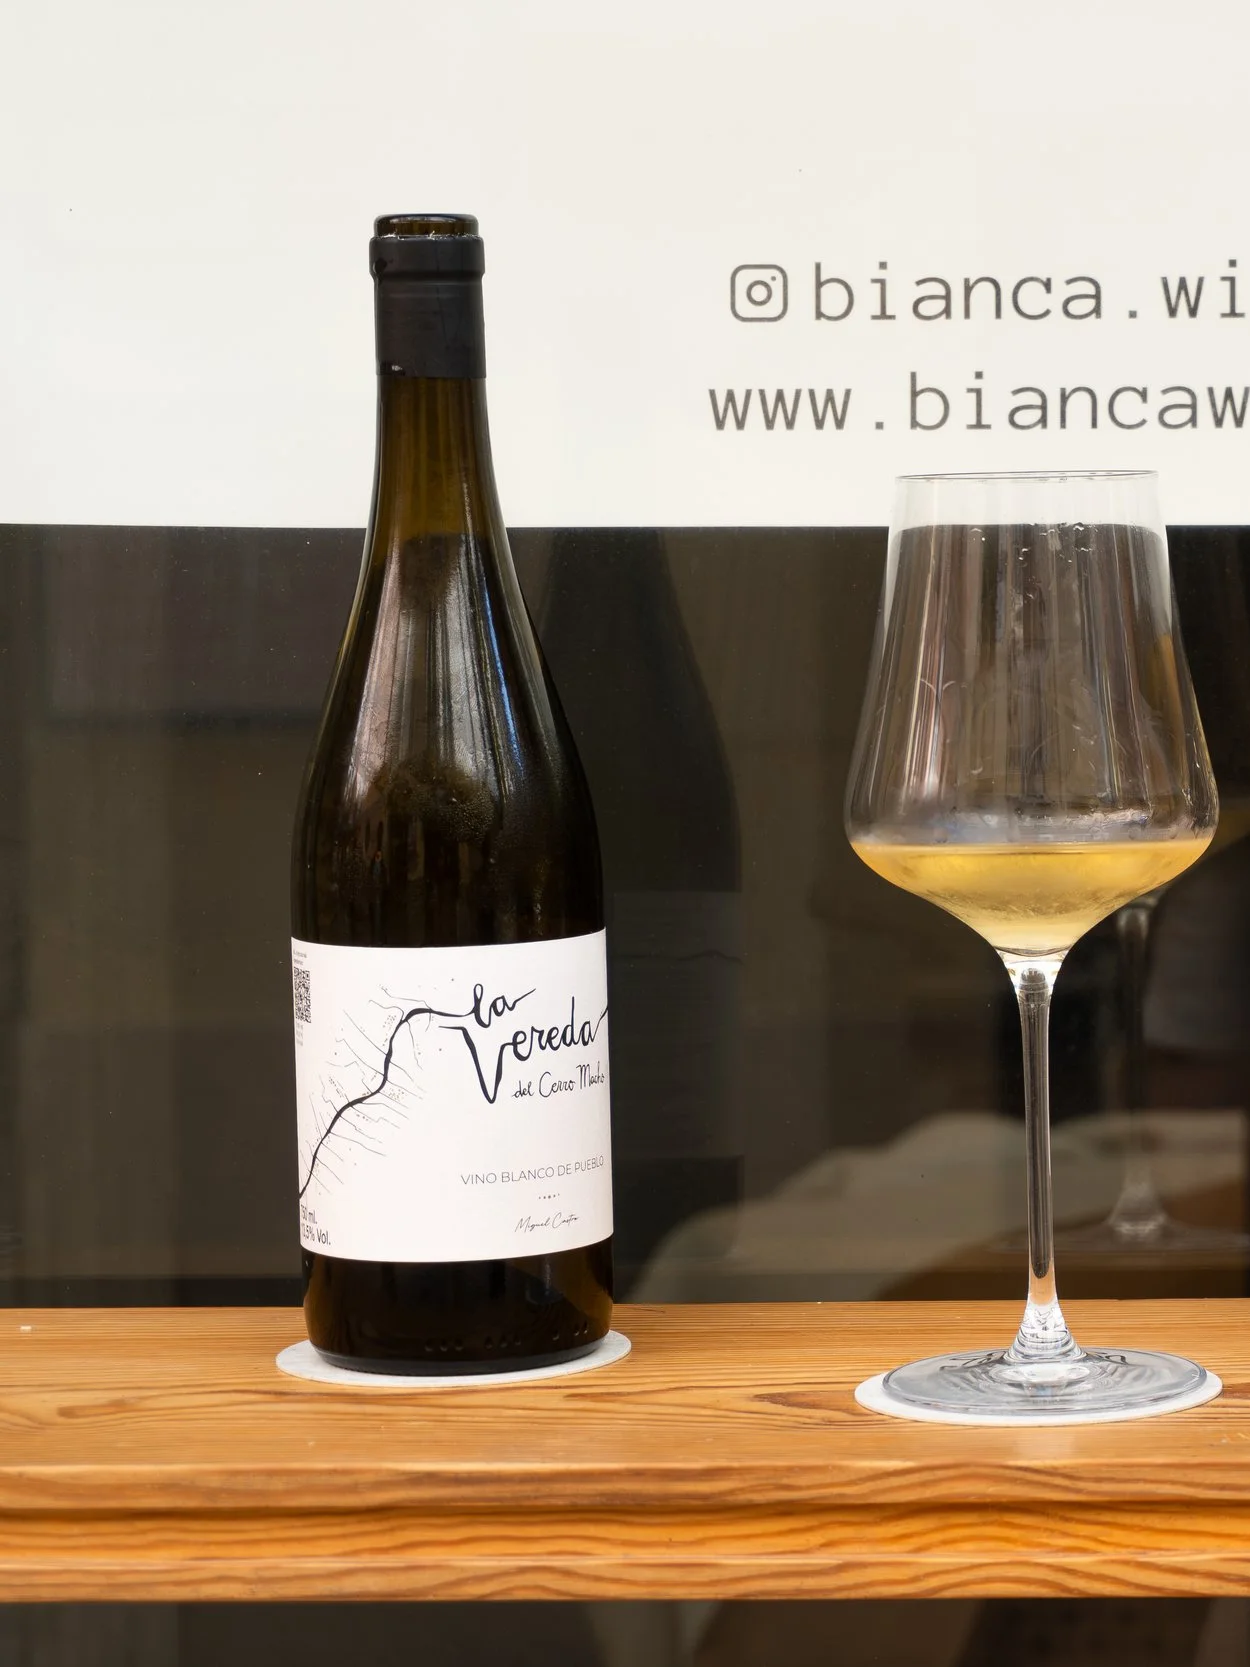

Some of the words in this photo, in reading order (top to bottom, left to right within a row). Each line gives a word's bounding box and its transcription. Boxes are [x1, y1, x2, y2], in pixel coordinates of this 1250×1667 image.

[439, 996, 607, 1104] Vereda
[512, 1079, 535, 1099] del
[538, 1071, 576, 1098] Cerro
[460, 1172, 498, 1186] VINO
[501, 1166, 555, 1184] BLANCO
[557, 1164, 572, 1177] DE
[574, 1155, 605, 1173] PUEBLO
[316, 1228, 332, 1246] Vol.
